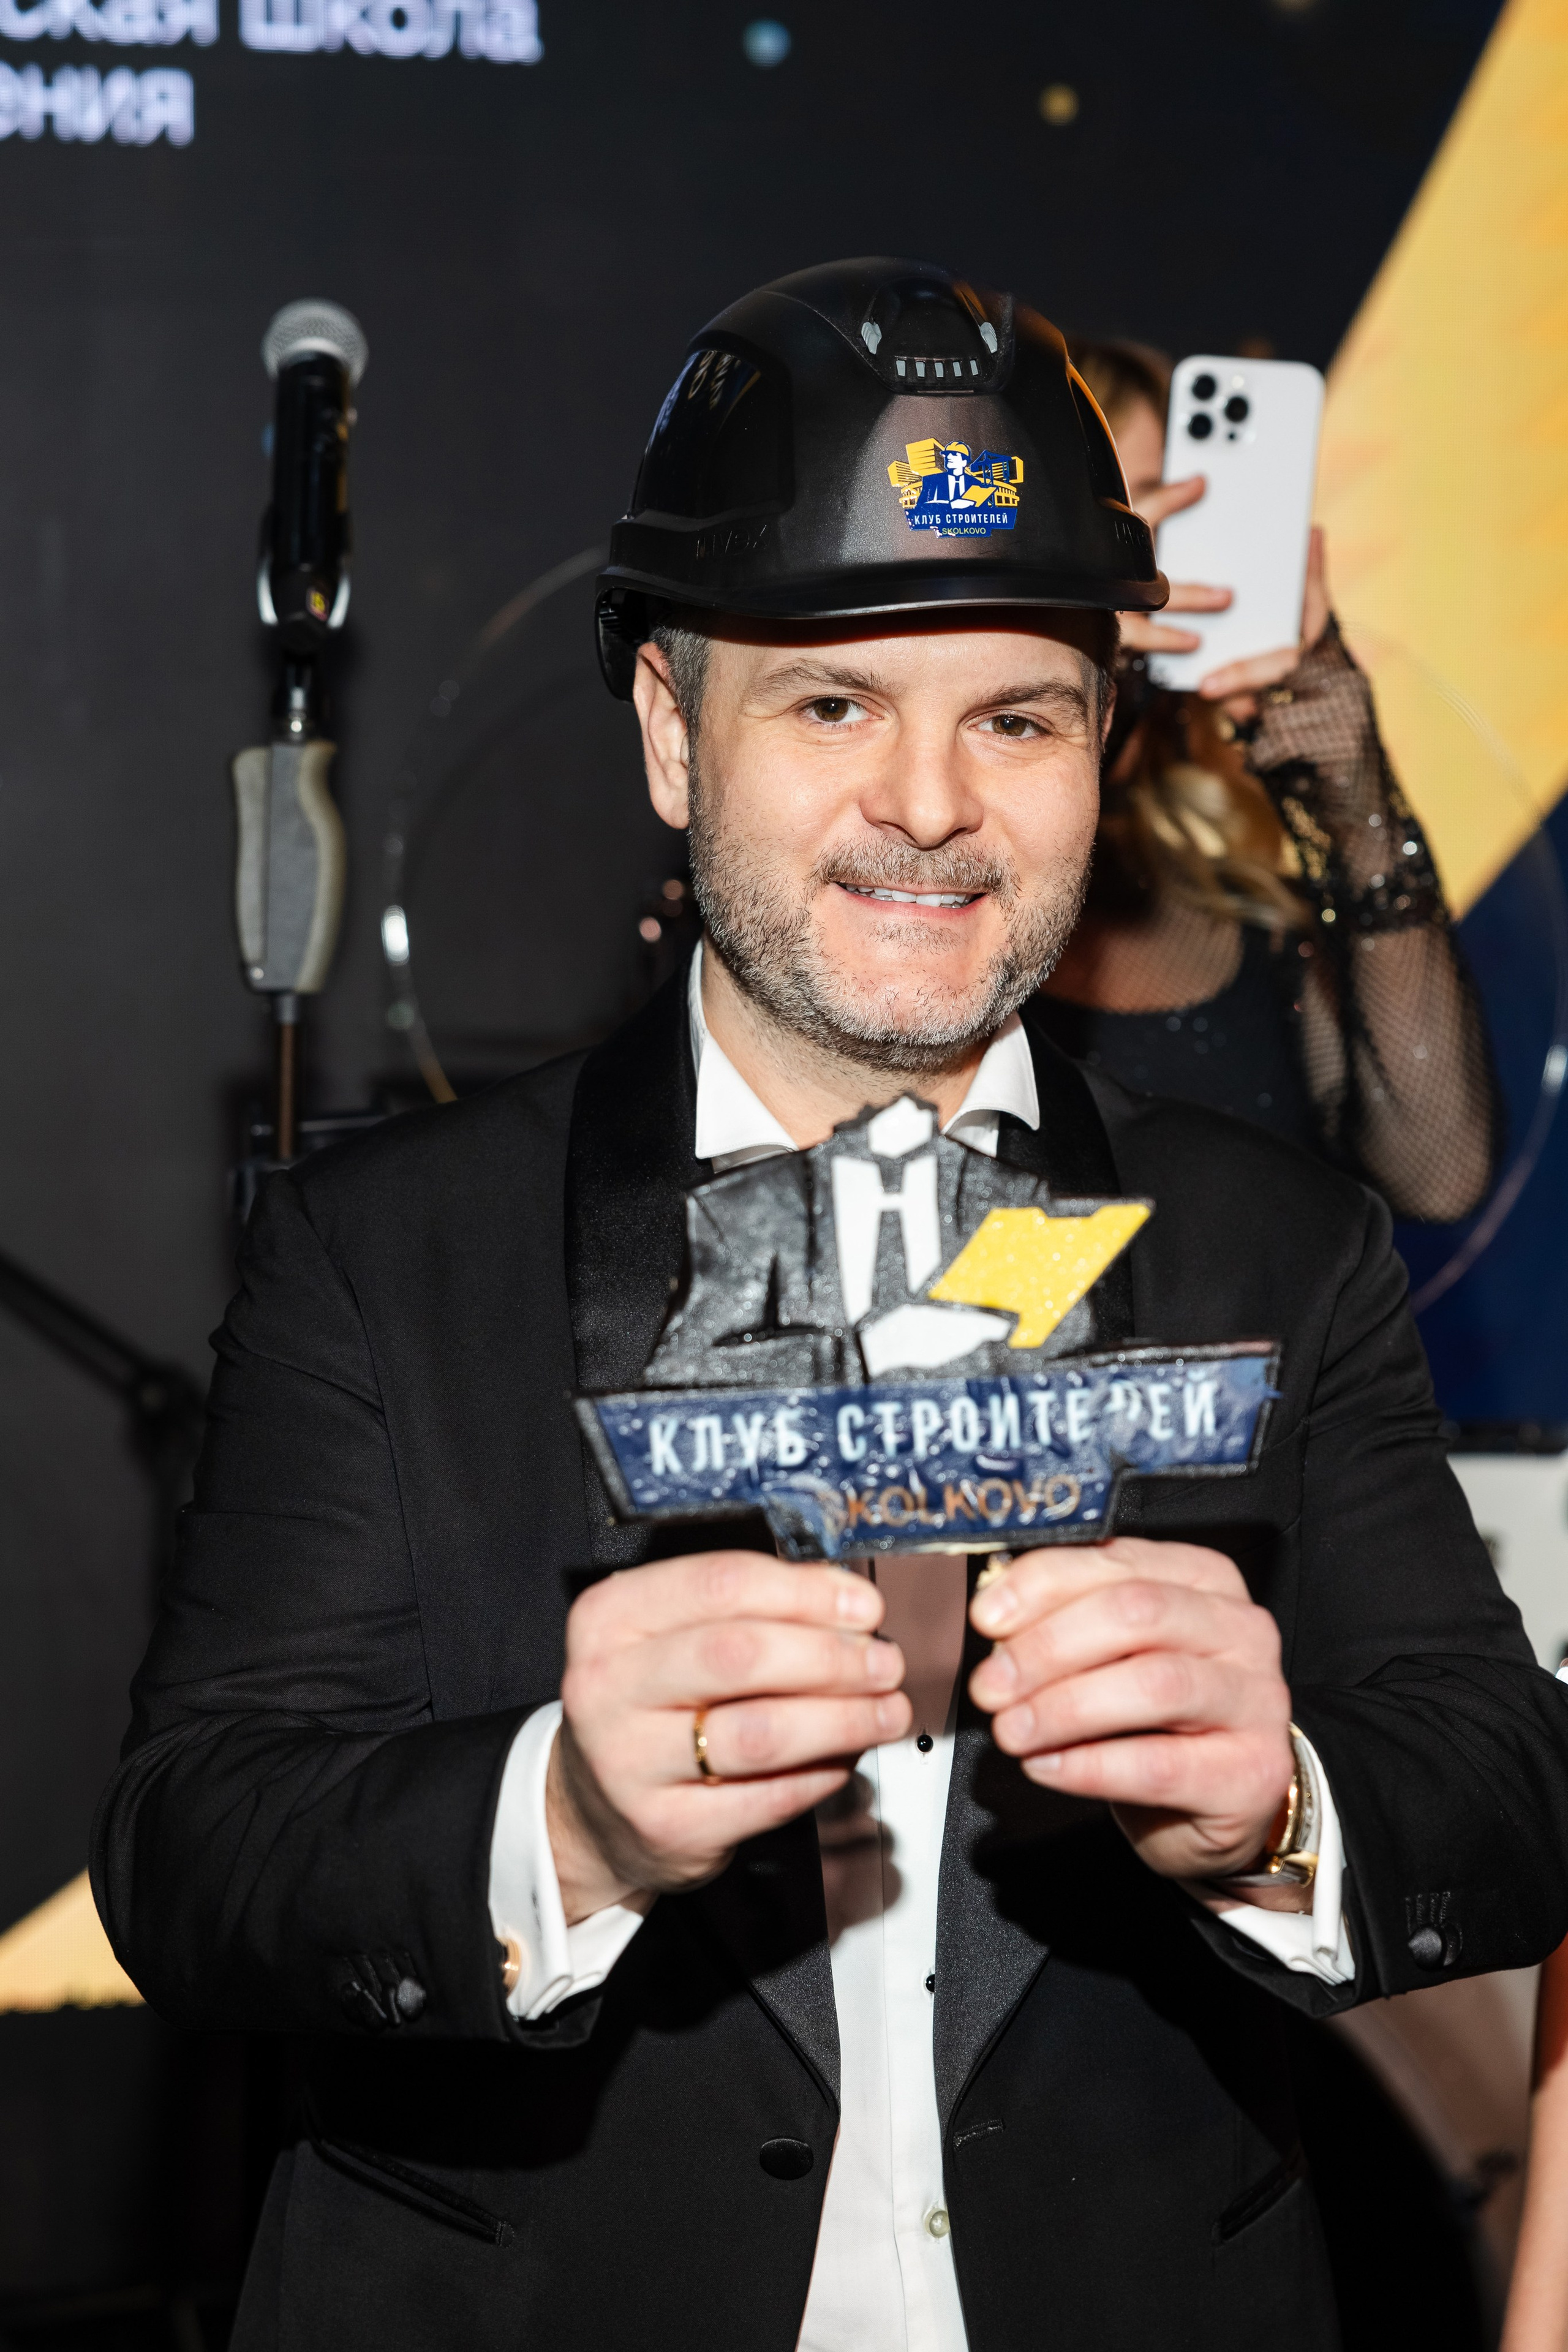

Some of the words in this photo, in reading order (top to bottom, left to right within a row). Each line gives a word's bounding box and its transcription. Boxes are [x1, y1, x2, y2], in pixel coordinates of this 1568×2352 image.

[914, 514, 941, 525] КЛУБ
[946, 512, 1008, 524] СТРОИТЕЛЕЙ
[942, 527, 986, 535] SKOLKOVO
[649, 1409, 809, 1476] КЛУБ
